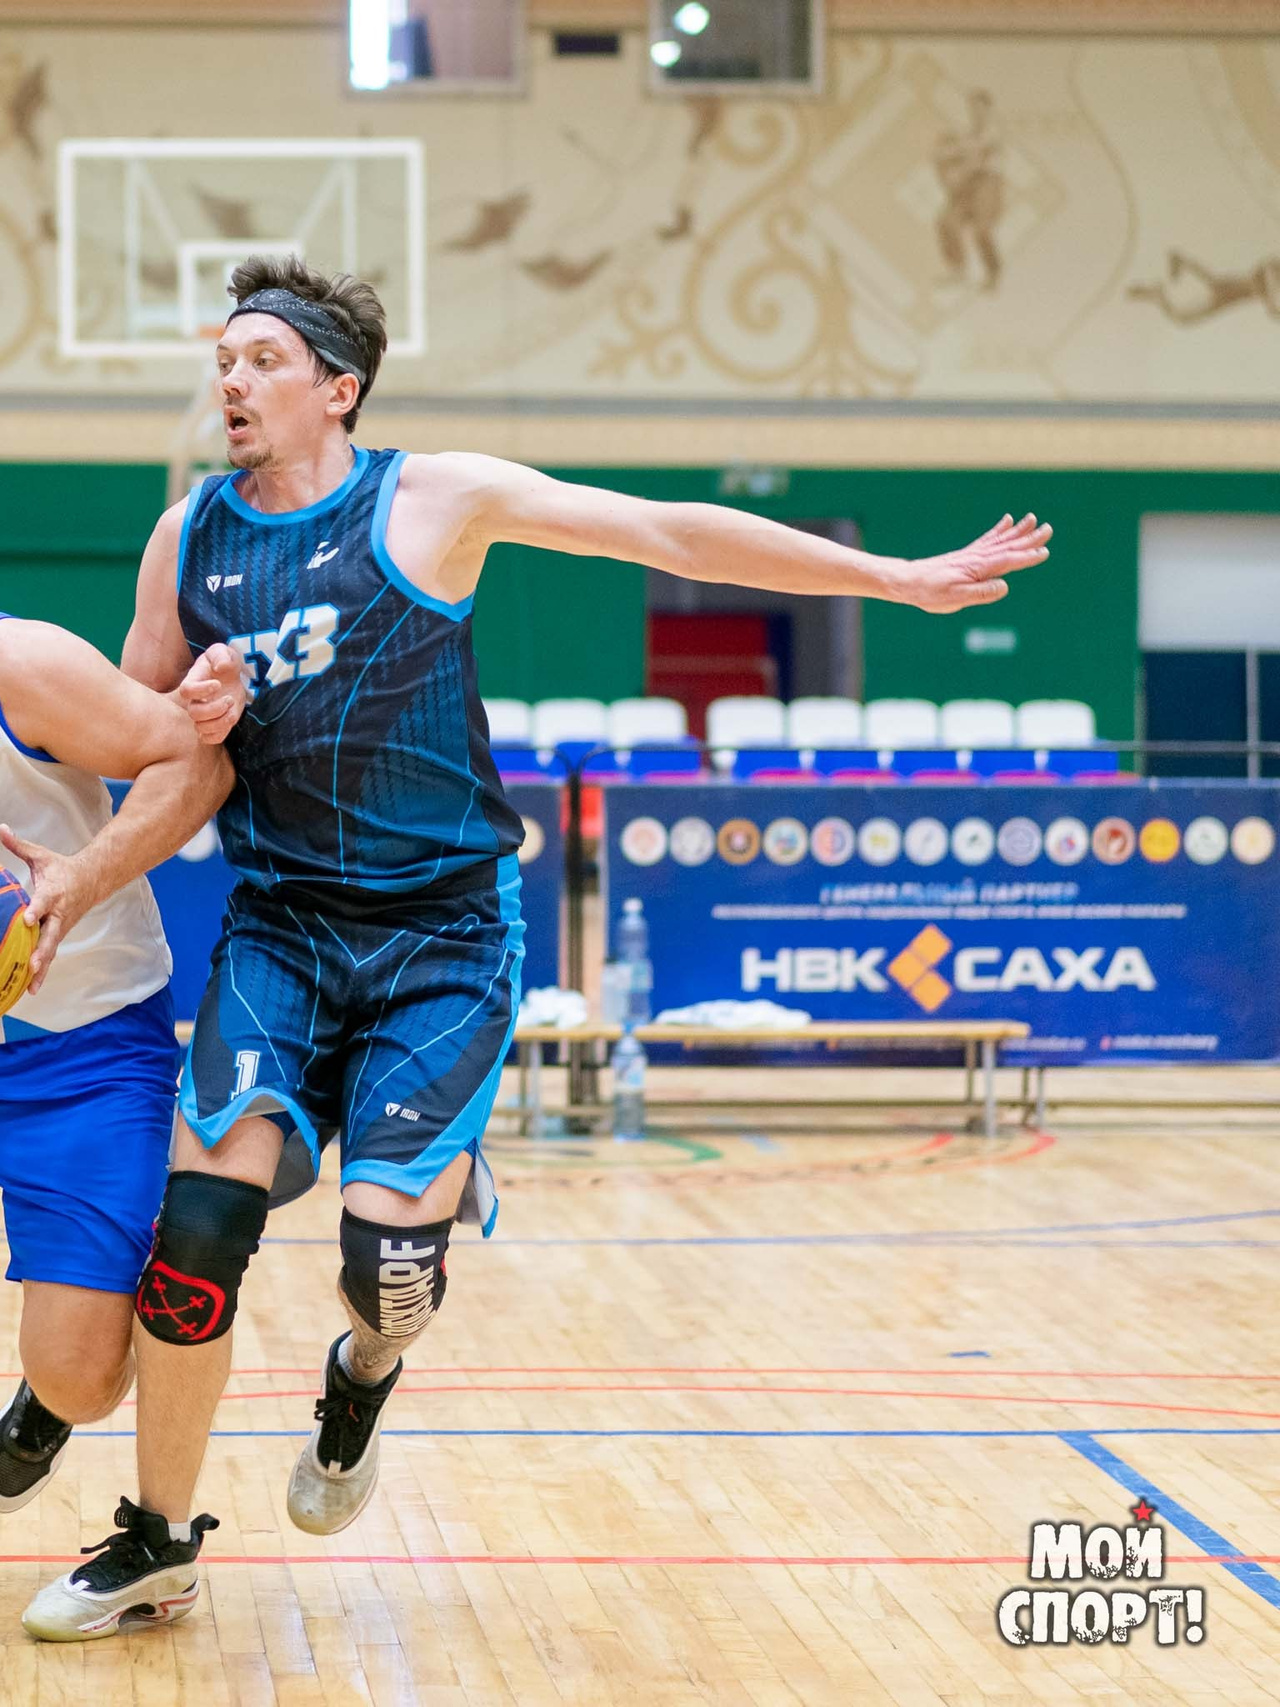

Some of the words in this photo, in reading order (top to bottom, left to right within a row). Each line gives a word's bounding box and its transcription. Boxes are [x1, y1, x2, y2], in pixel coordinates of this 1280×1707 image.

[223, 574, 243, 588] IRON
[741, 947, 890, 992] НВК
[953, 946, 1157, 993] САХА
[231, 1050, 261, 1101] 1
[400, 1107, 421, 1122] IRON
